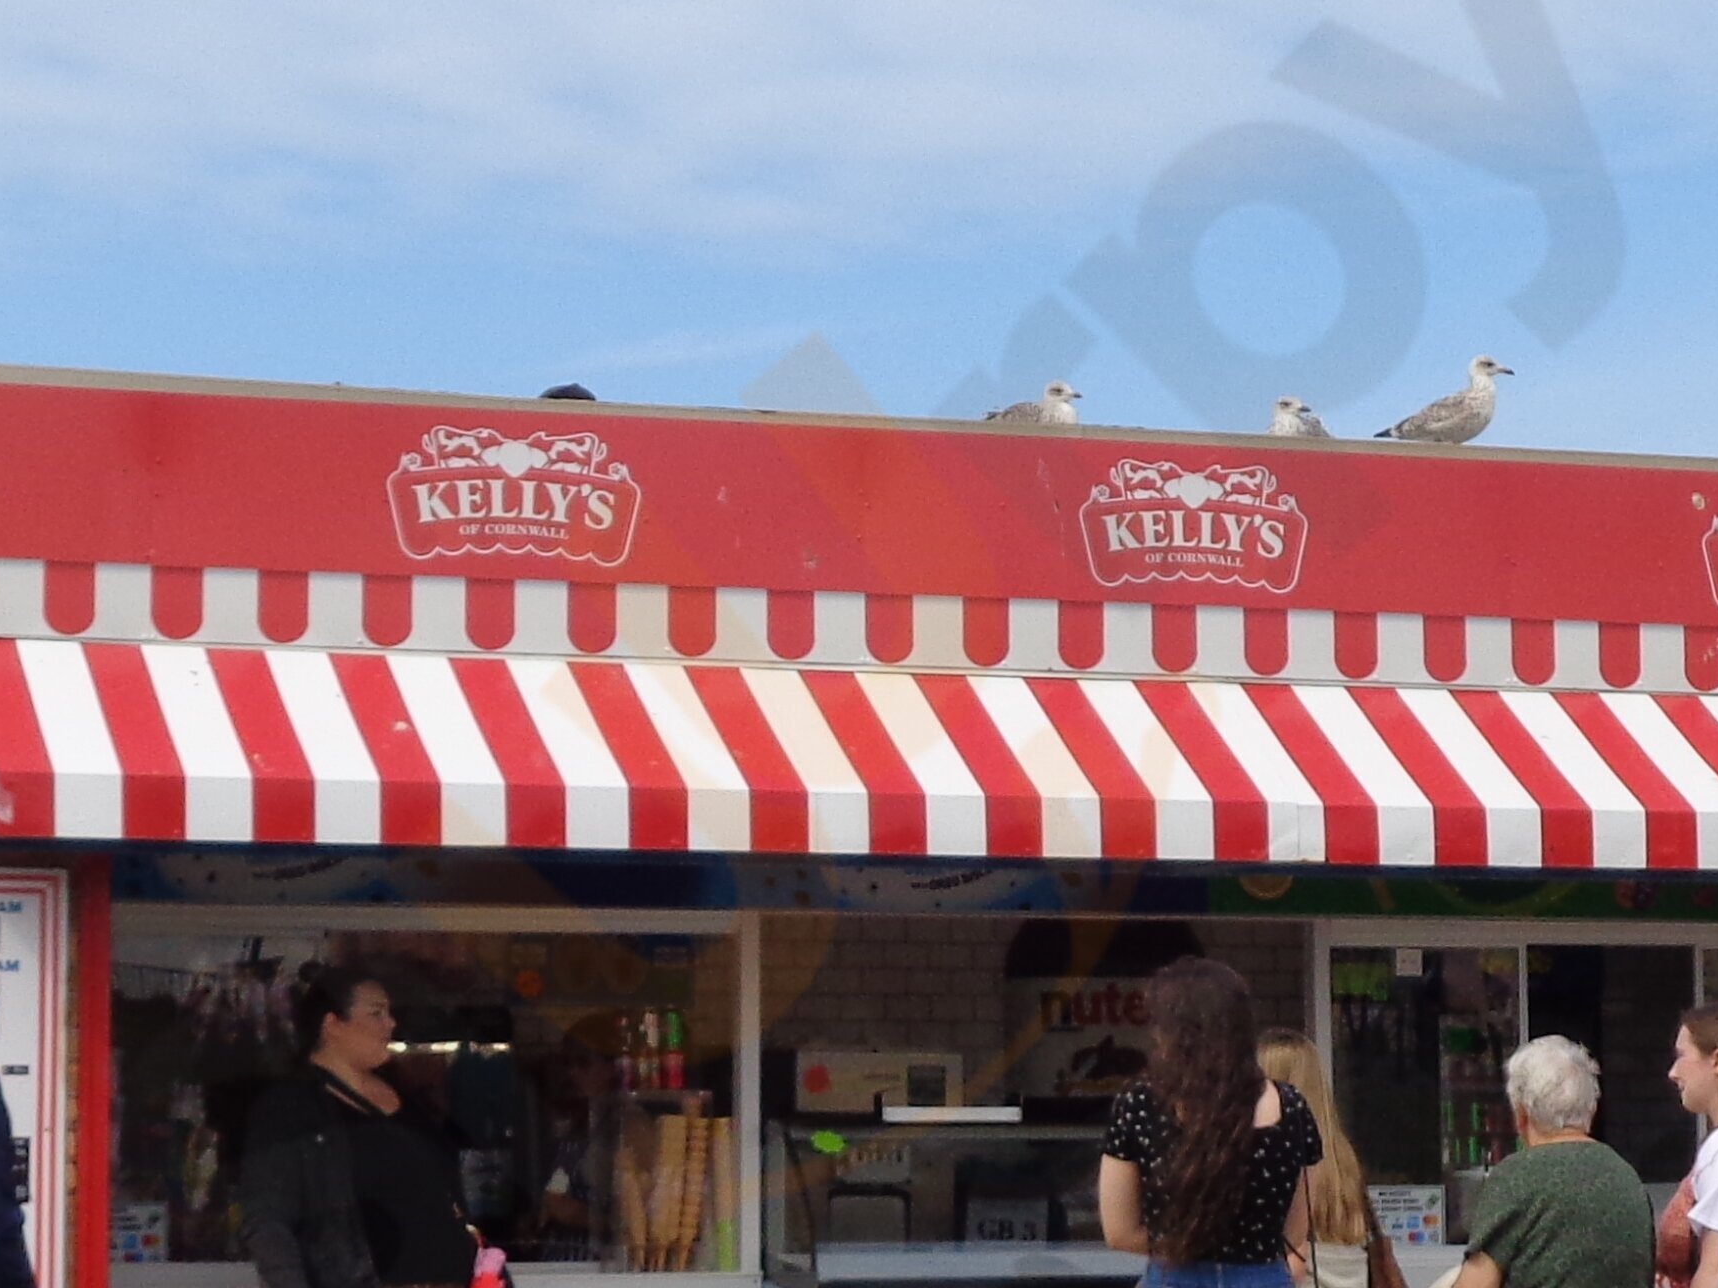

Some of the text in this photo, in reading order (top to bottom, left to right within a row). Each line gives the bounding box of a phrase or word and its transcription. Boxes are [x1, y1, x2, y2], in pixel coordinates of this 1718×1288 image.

[411, 479, 616, 530] KELLY'S
[459, 523, 569, 540] OF CORNWALL
[1101, 510, 1285, 559] KELLY'S
[1145, 552, 1244, 567] OF CORNWALL
[1041, 981, 1149, 1026] nute
